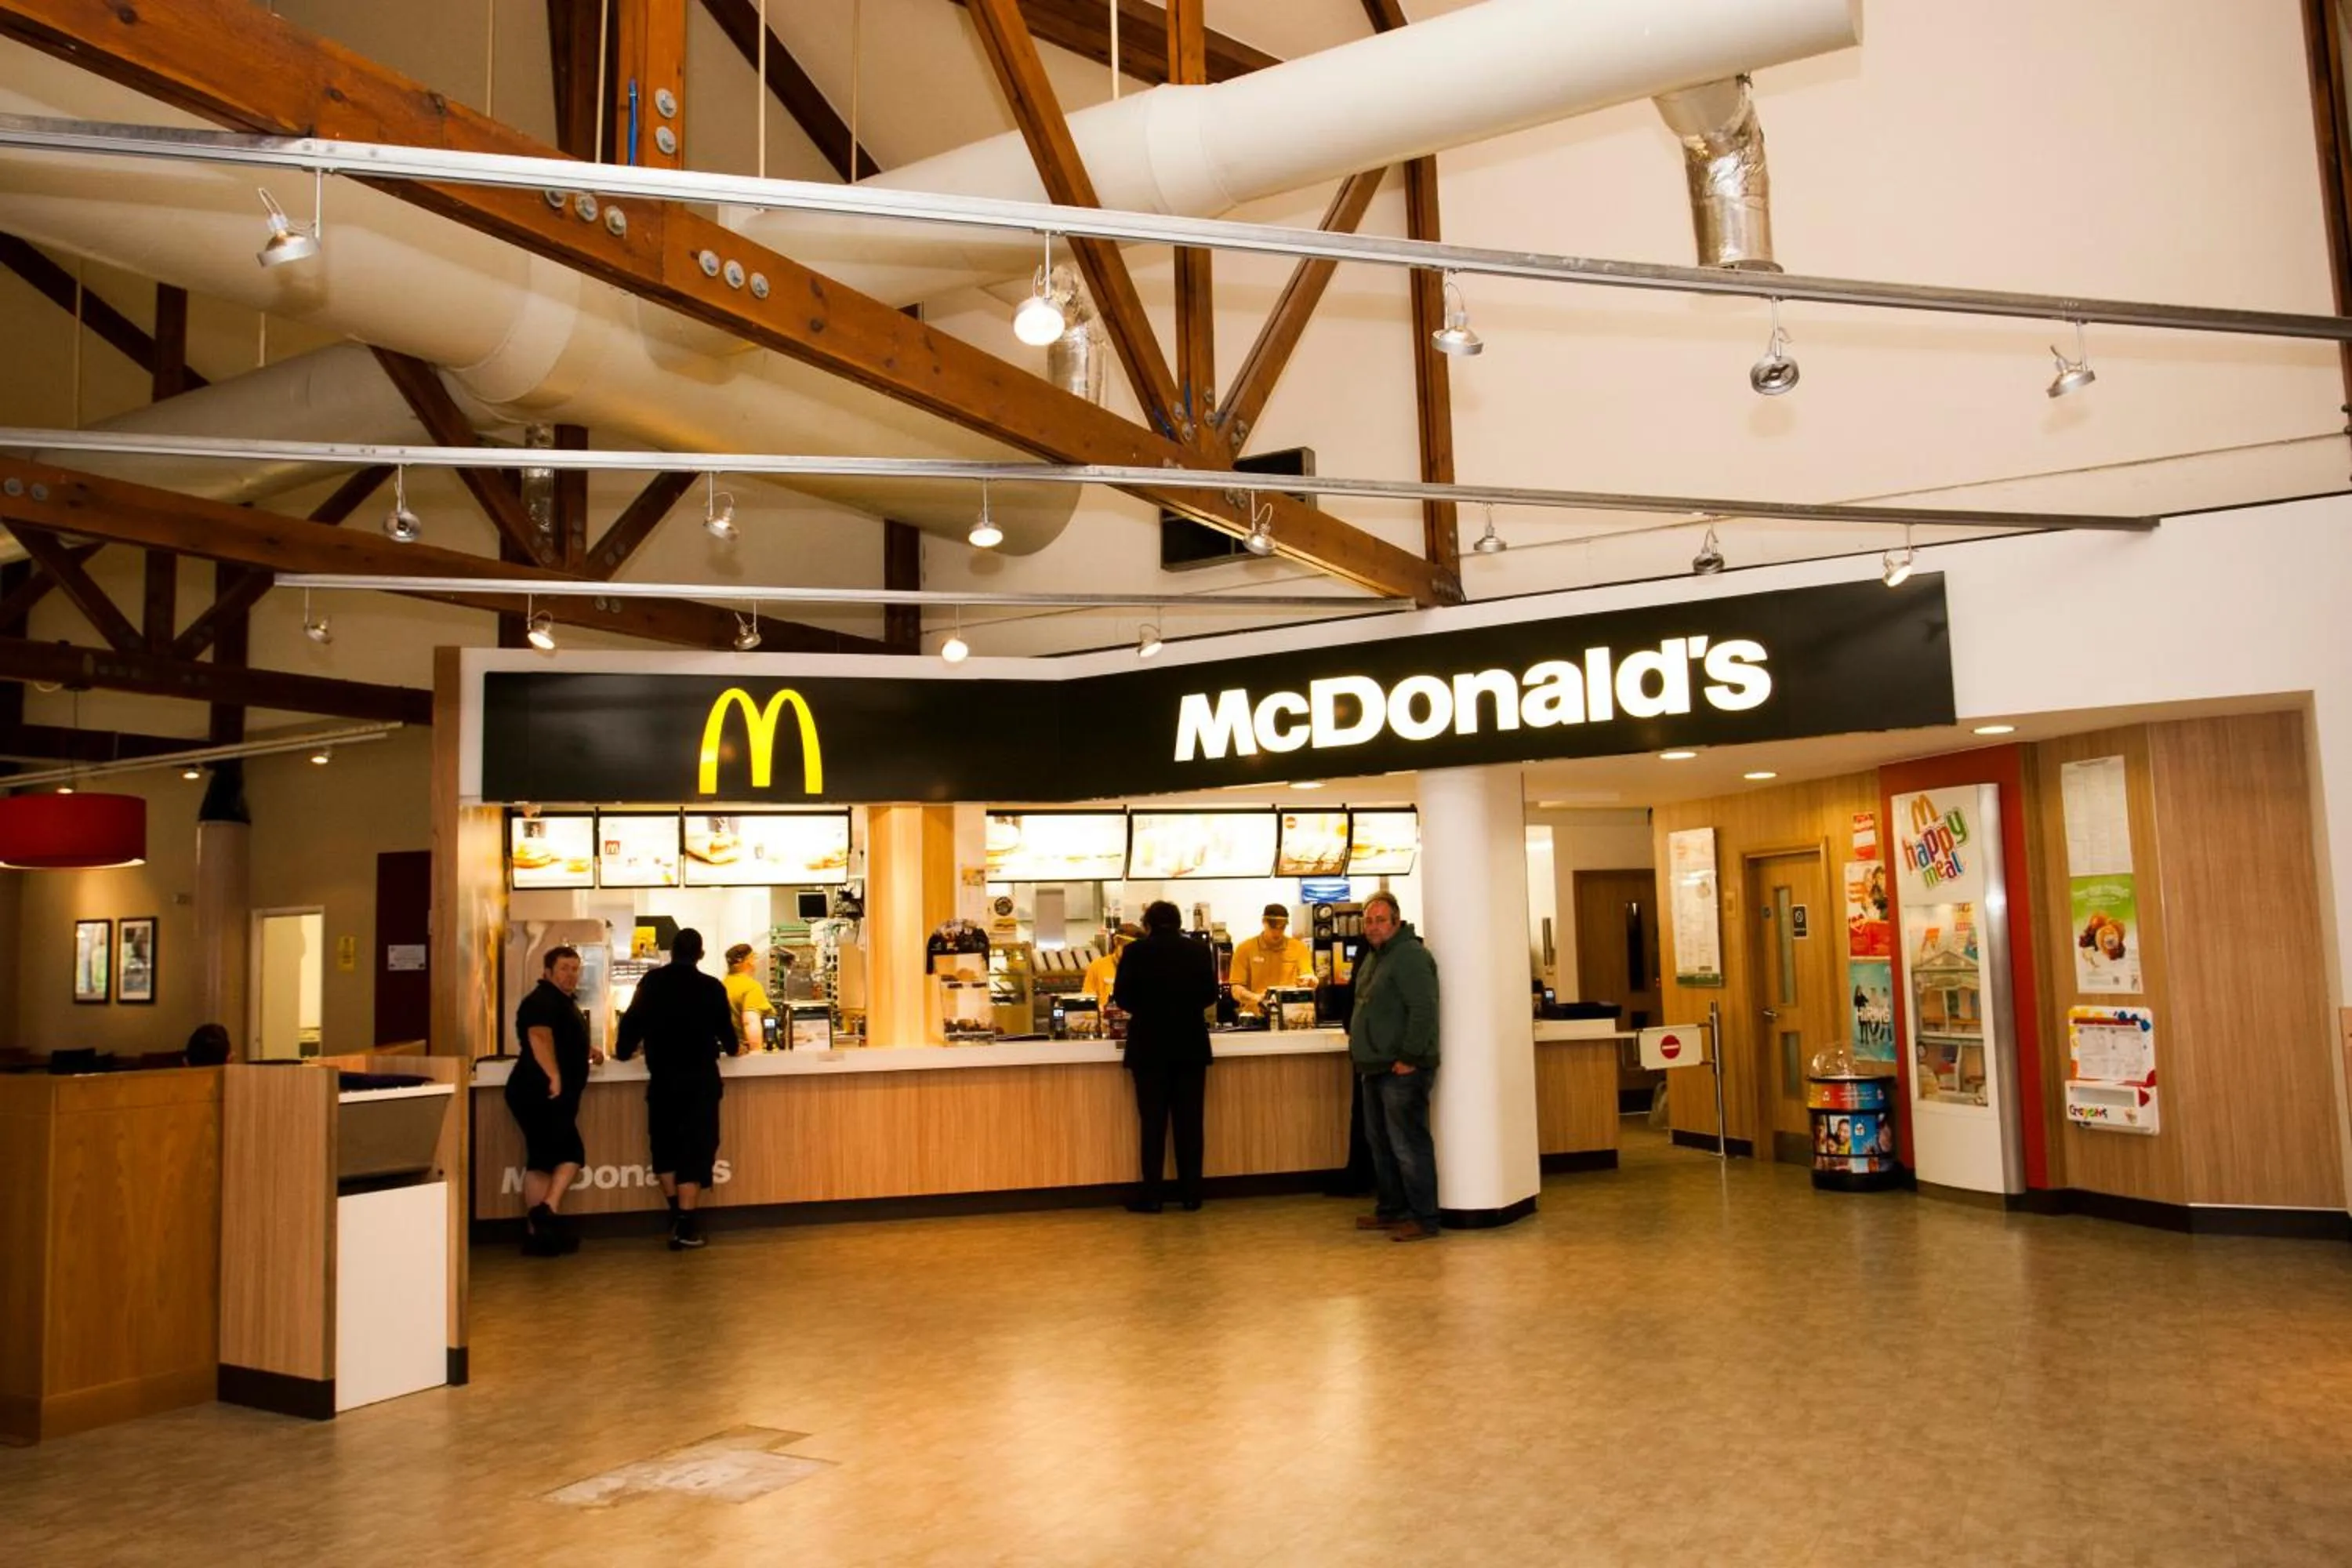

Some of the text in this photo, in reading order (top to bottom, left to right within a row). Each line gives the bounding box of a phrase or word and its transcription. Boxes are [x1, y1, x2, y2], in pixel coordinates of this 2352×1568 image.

[1174, 635, 1773, 762] McDonald's
[1902, 808, 1969, 875] happy
[1923, 851, 1963, 890] meal
